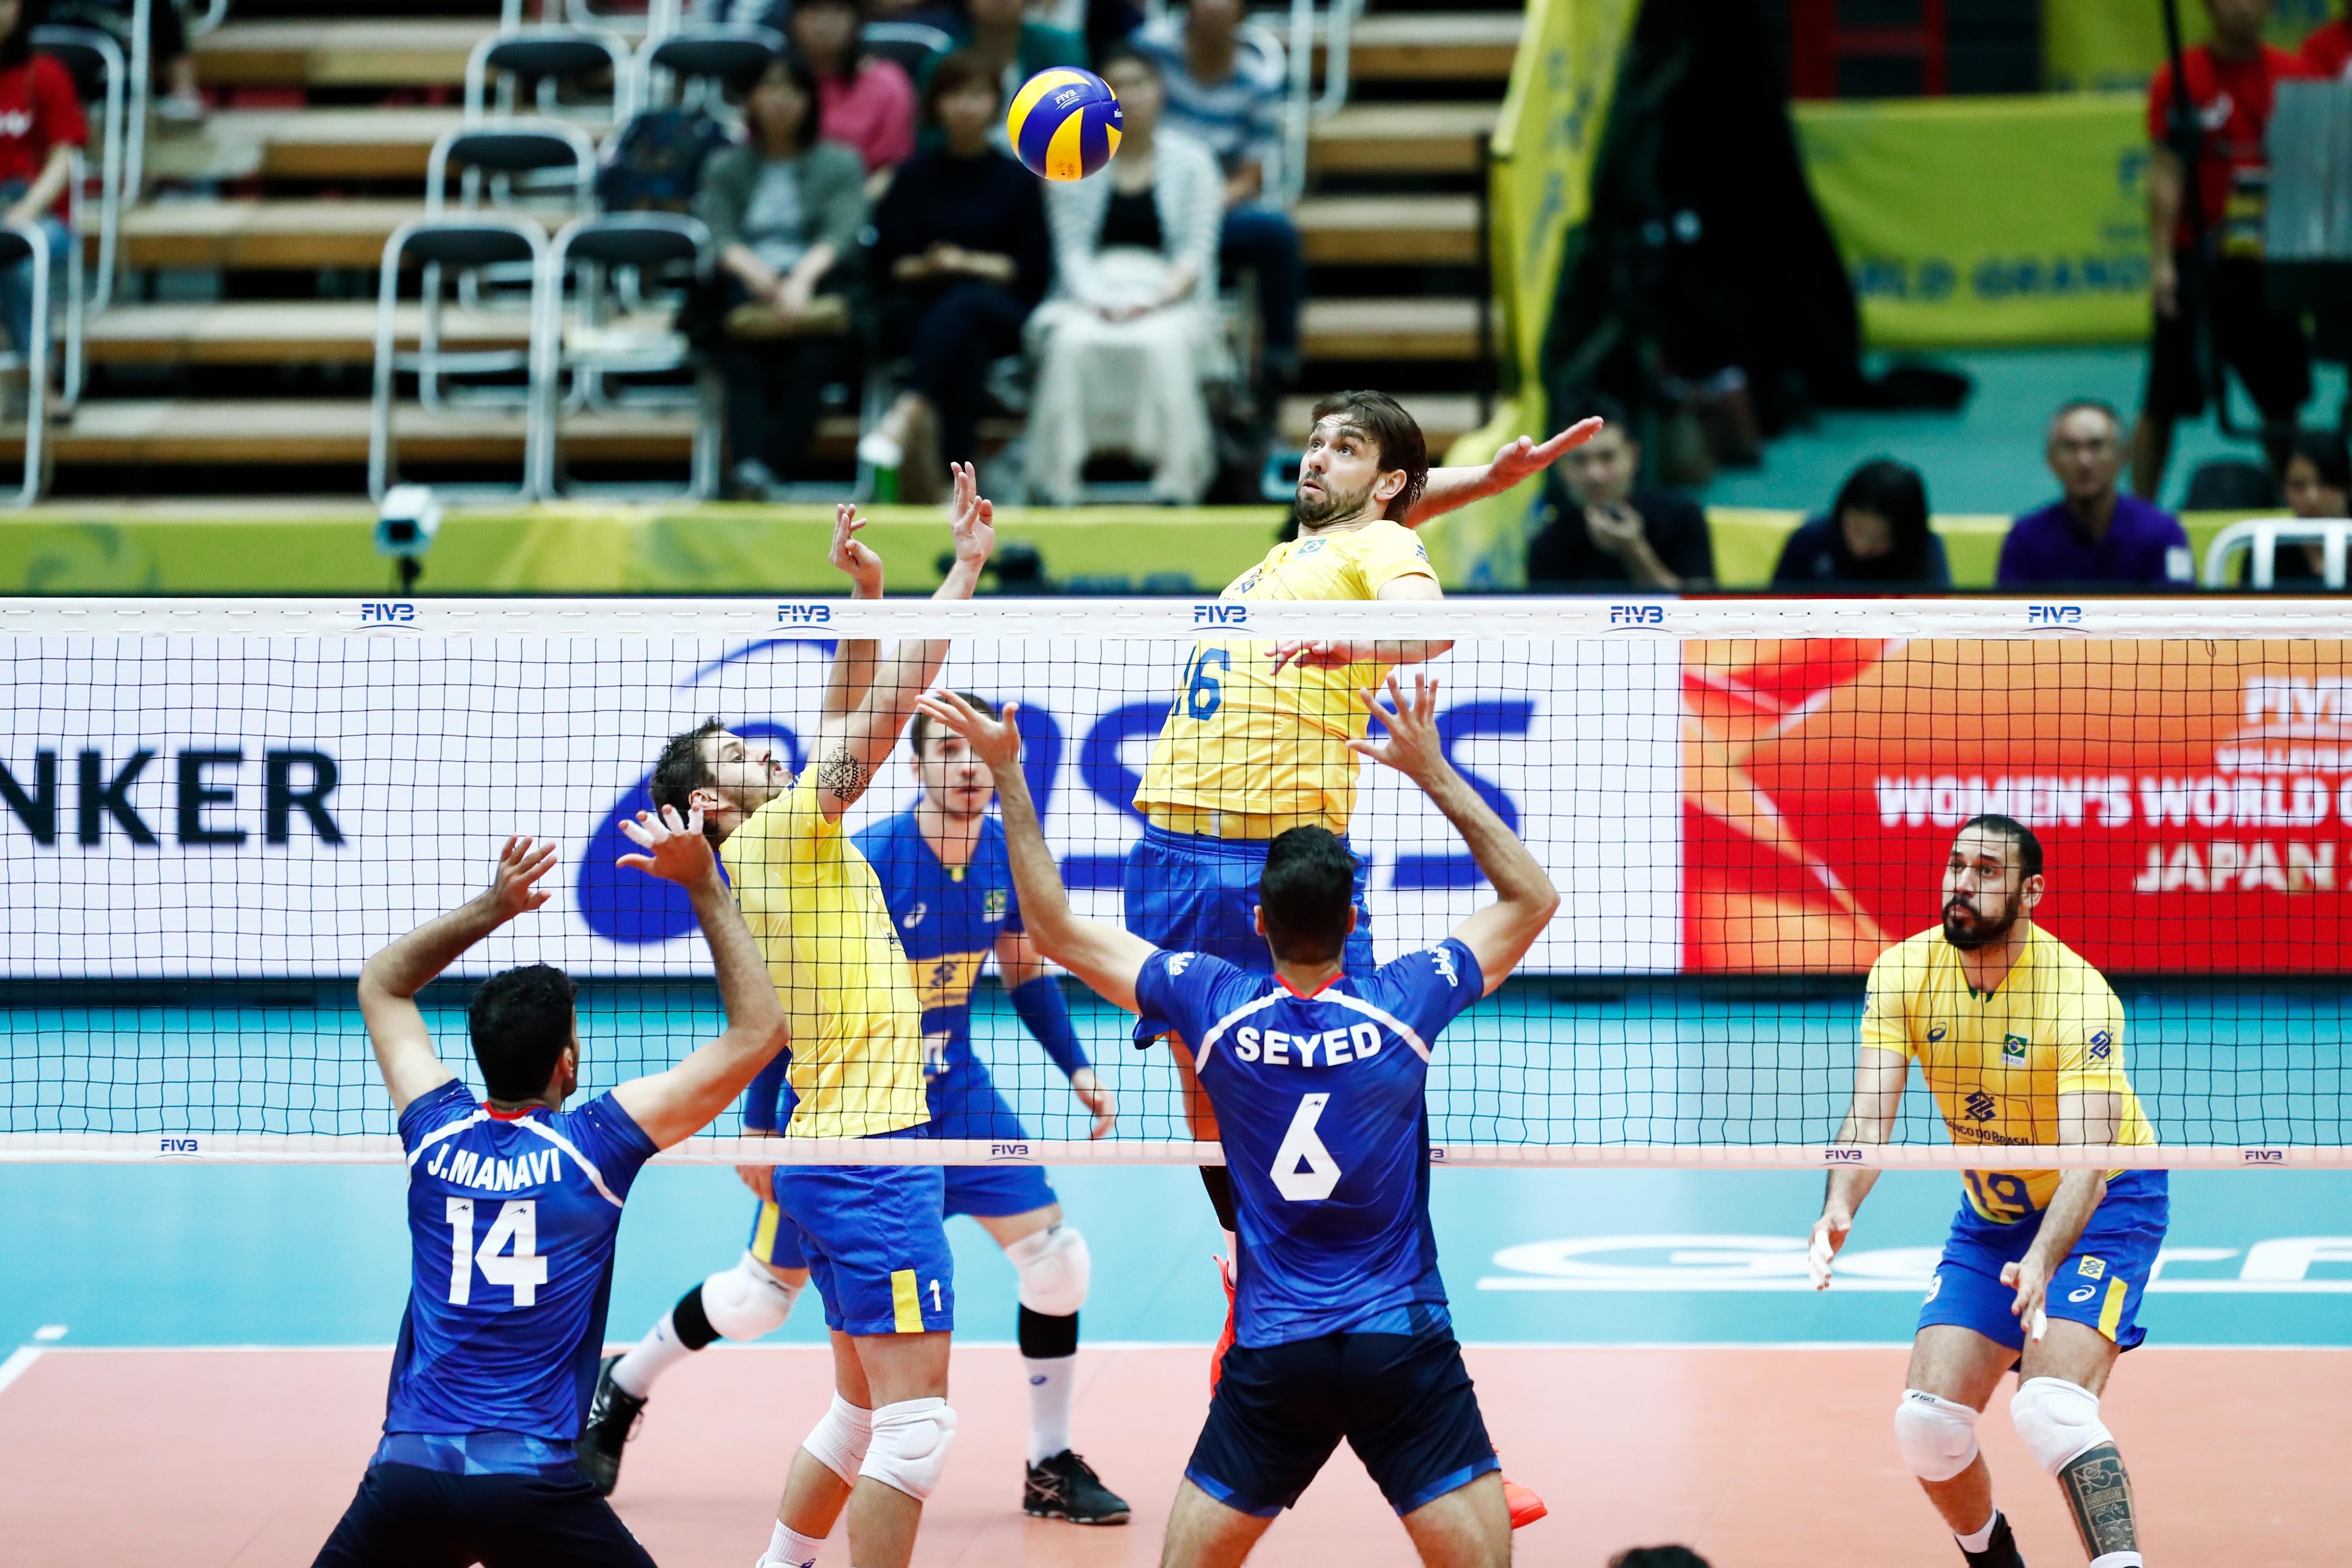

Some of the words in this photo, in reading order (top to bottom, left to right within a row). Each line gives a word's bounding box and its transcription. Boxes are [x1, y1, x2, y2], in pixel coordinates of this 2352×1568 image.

[1055, 89, 1076, 104] FIVB
[362, 604, 415, 621] FIVB
[778, 605, 830, 622] FIVB
[1194, 606, 1247, 623] FIVB
[1611, 606, 1663, 623] FIVB
[2029, 606, 2082, 623] FIVB
[1875, 775, 2132, 829] WOMEN'S
[2139, 776, 2330, 828] WORLD
[2132, 839, 2336, 893] JAPAN
[1235, 1022, 1382, 1067] SEYED
[161, 1139, 198, 1151] FIVB
[992, 1144, 1028, 1155] FIVB
[1269, 1093, 1342, 1201] 6
[1825, 1150, 1863, 1159] FIVB
[2245, 1151, 2282, 1160] FIVB
[427, 1143, 561, 1191] J.MANAVI
[1964, 1169, 2035, 1221] 19
[446, 1196, 548, 1307] 14
[929, 1279, 942, 1312] 1
